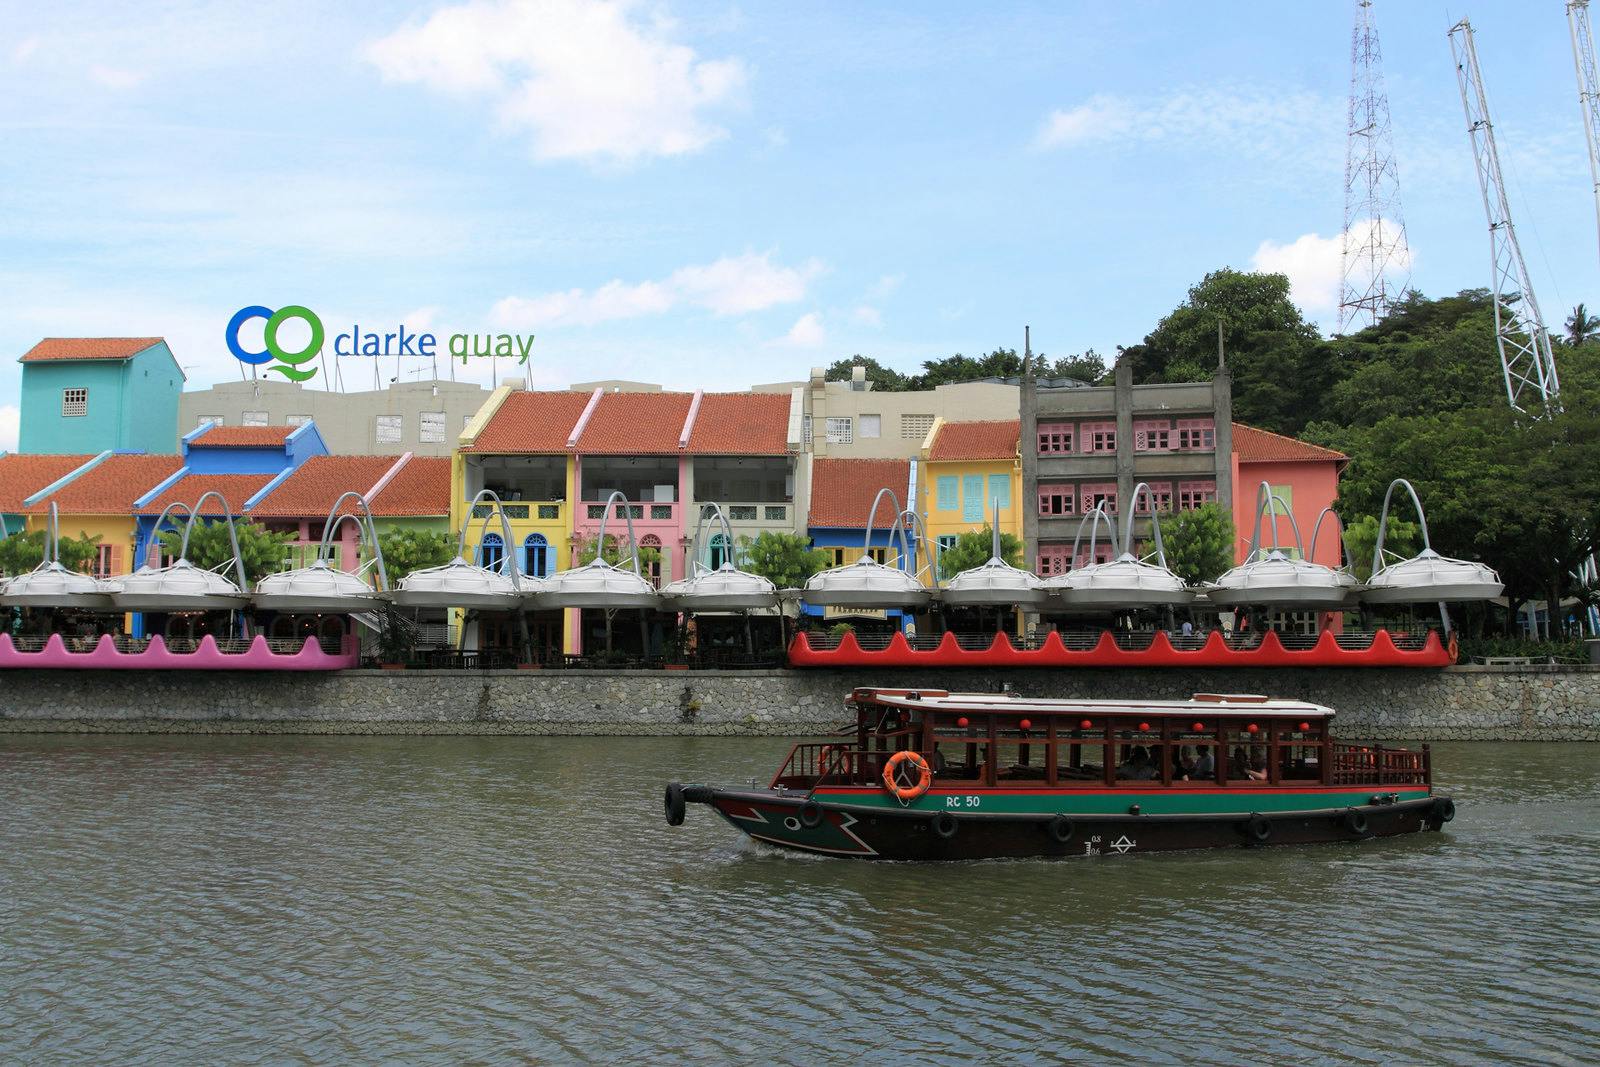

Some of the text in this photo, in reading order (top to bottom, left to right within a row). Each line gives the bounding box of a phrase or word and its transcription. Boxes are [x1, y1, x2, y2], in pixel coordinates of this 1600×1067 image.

[334, 325, 437, 357] clarke
[449, 333, 535, 365] quay
[946, 796, 980, 807] RC 50
